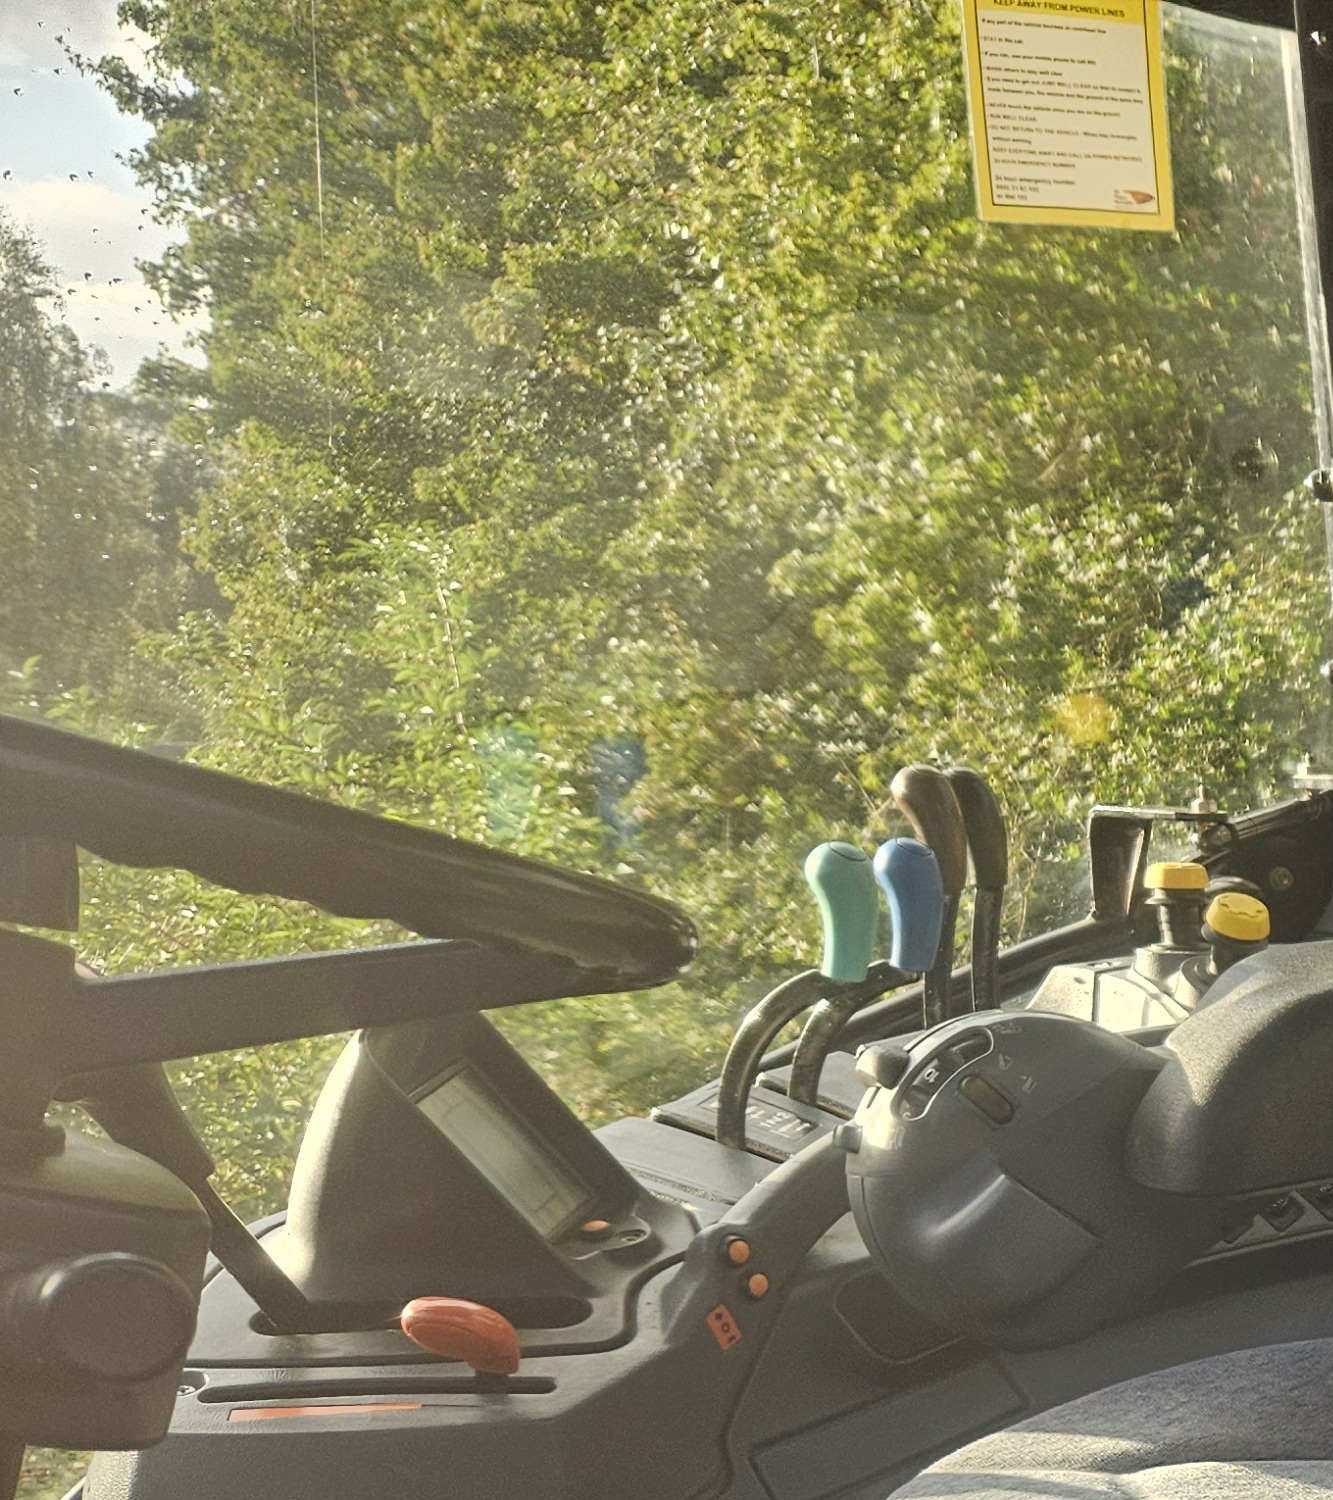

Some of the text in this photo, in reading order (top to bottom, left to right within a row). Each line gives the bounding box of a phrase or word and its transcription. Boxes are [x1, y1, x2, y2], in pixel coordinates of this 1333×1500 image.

[1017, 0, 1041, 8] AWAY
[1044, 3, 1068, 11] FROM
[1070, 5, 1100, 14] POWER
[1102, 9, 1125, 17] LINES
